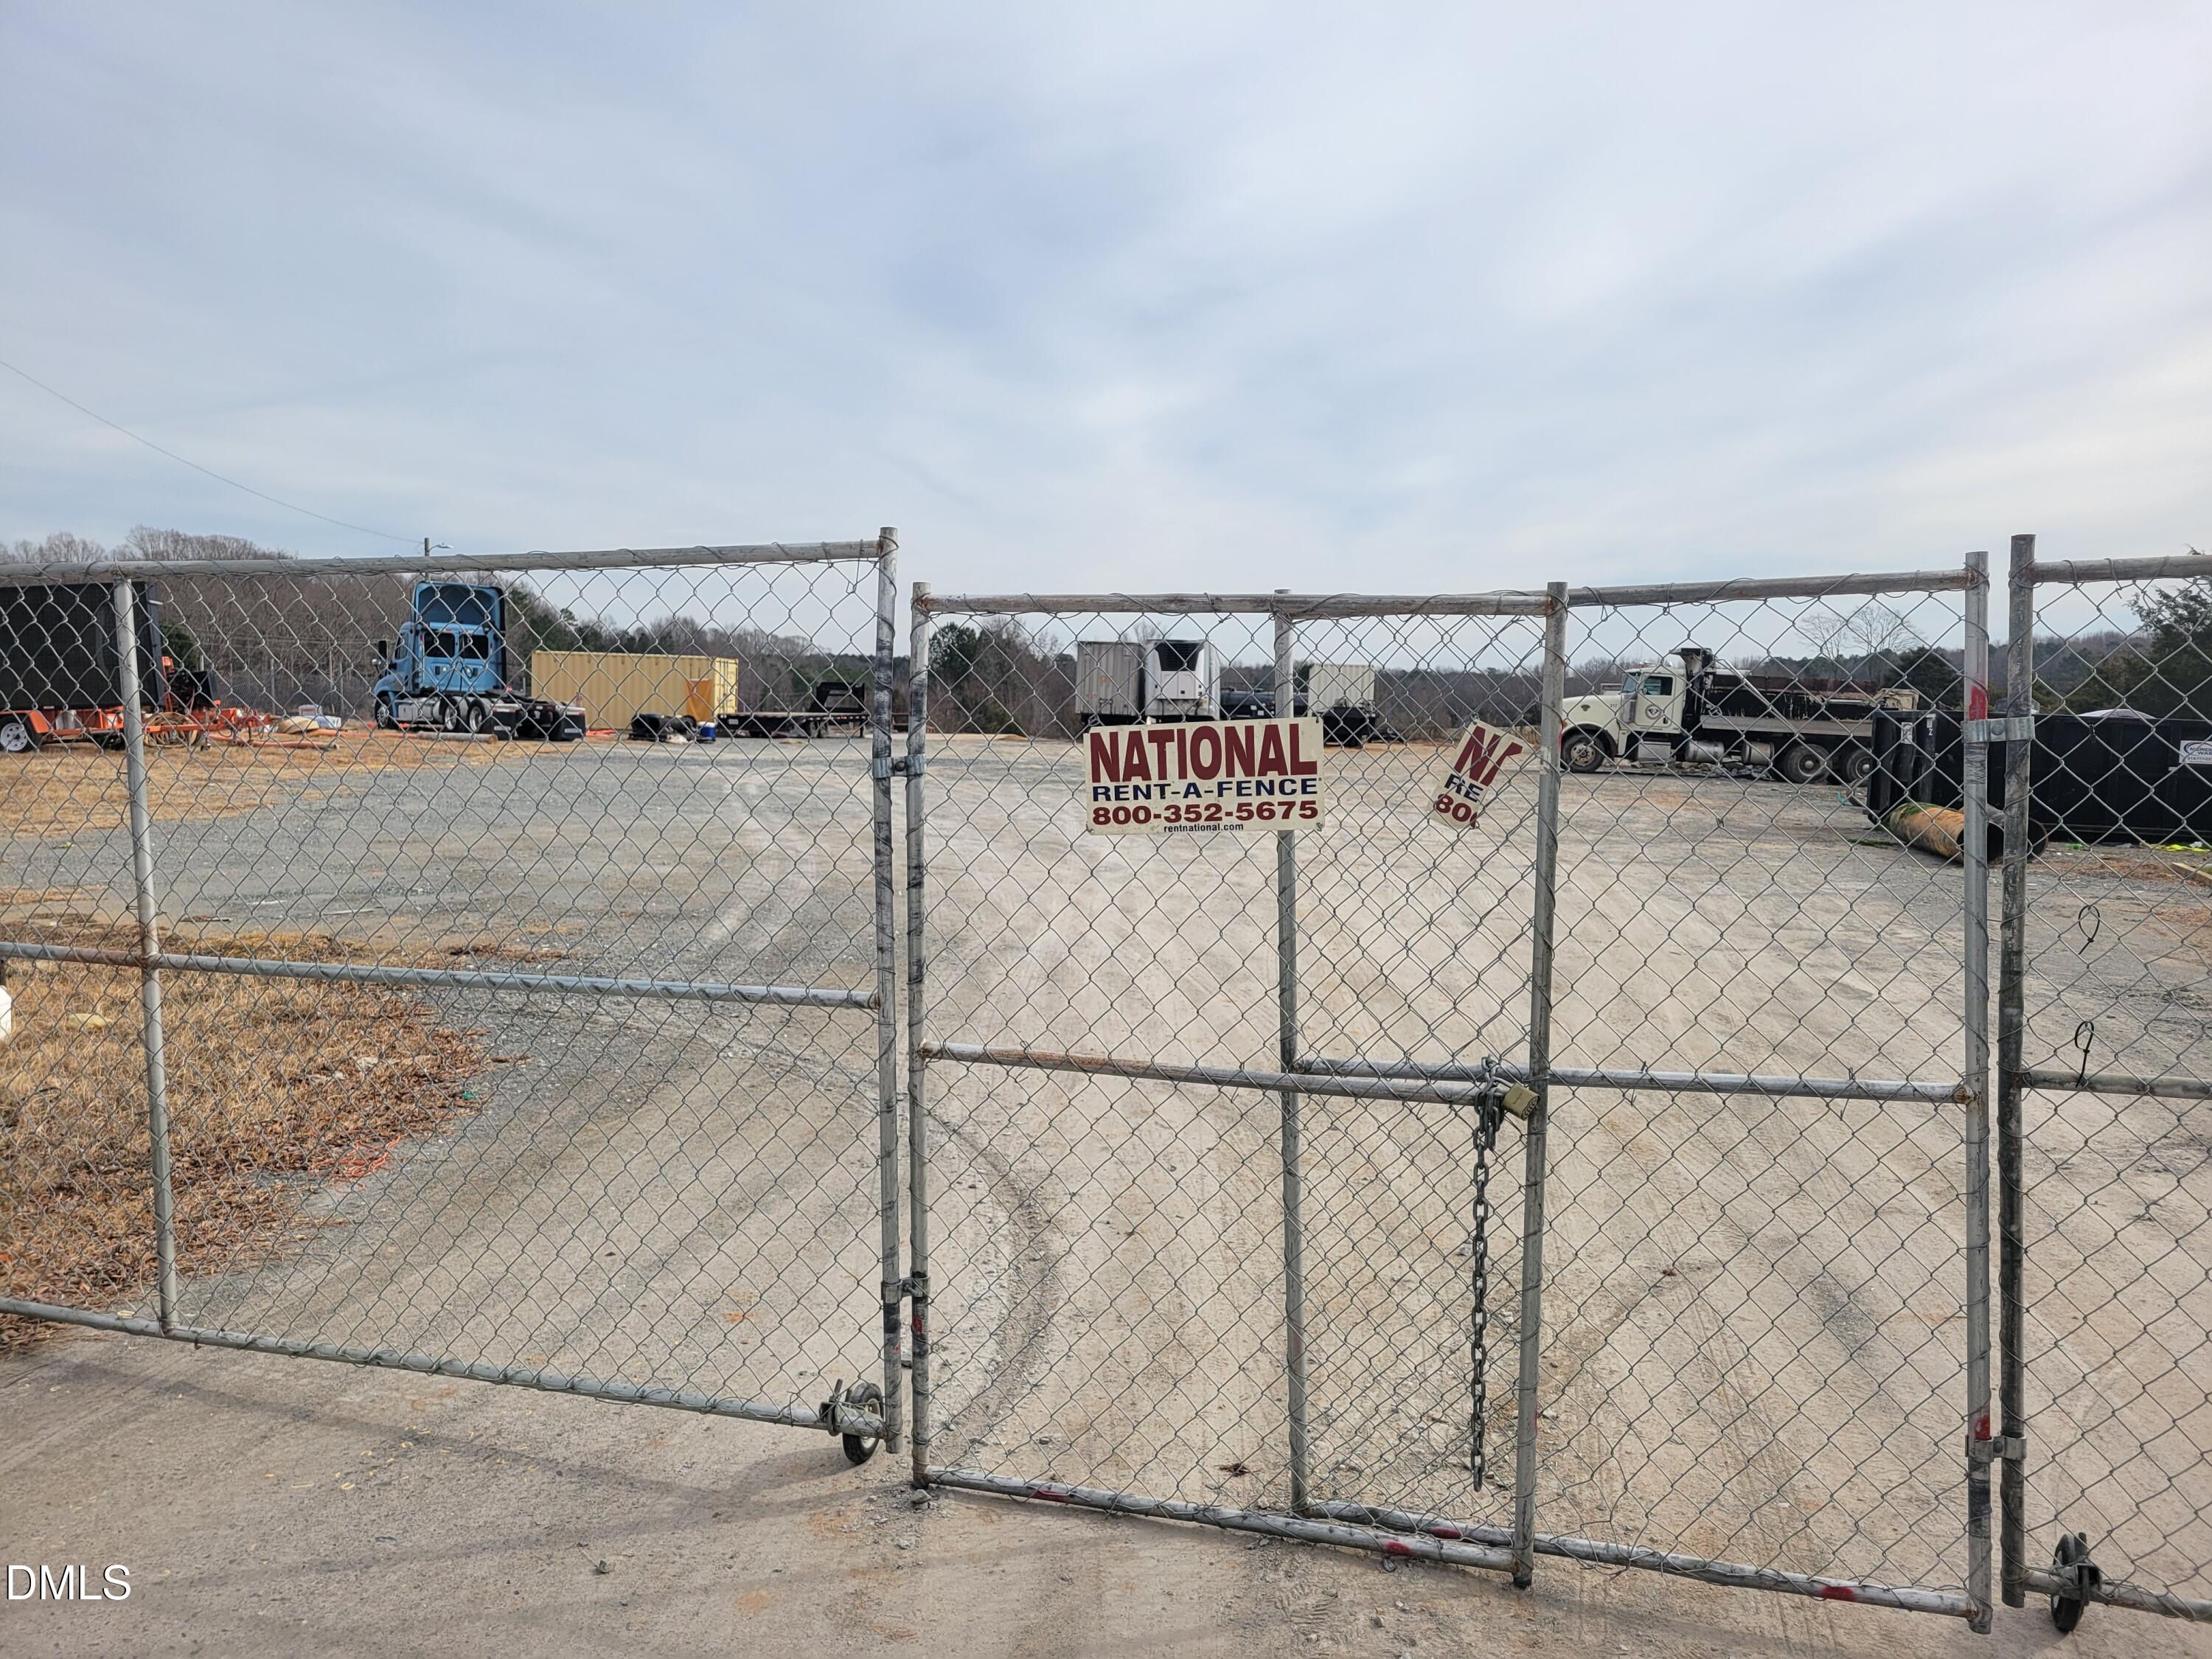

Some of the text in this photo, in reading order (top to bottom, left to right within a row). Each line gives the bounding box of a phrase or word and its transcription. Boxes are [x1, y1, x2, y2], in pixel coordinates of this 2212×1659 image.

[1090, 723, 1318, 783] NATIONAL
[1092, 778, 1318, 802] RENT-A-FENCE
[1444, 773, 1484, 803] RE
[1092, 800, 1318, 825] 800-352-5675
[1164, 822, 1244, 833] rentnational.com
